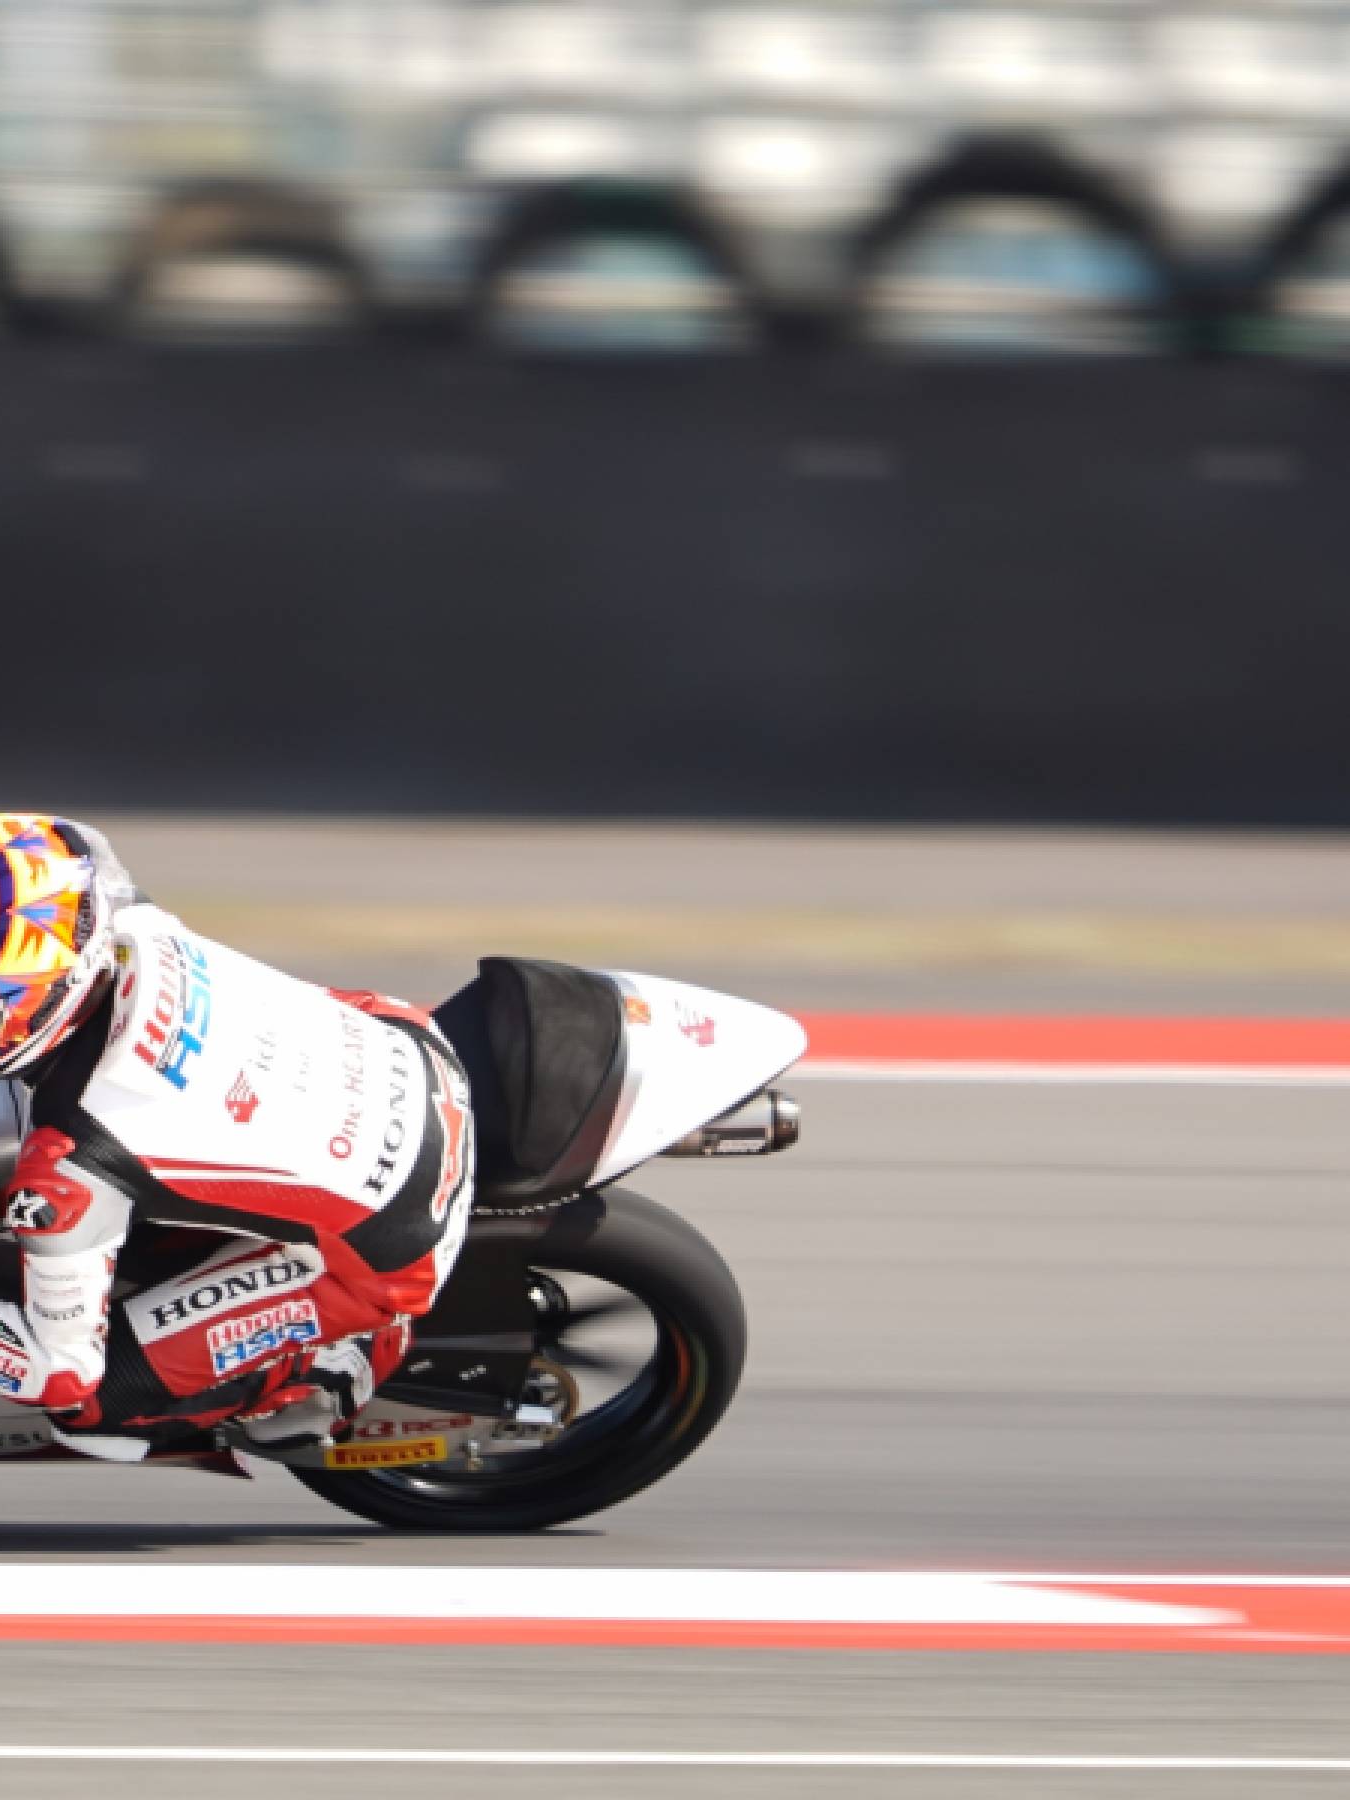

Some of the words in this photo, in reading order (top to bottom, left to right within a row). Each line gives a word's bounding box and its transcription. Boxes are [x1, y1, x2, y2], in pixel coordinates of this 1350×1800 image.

[151, 1258, 314, 1330] HONDA
[209, 1302, 316, 1346] Honda
[216, 1322, 317, 1371] Asia
[336, 1441, 439, 1465] PIRELLI
